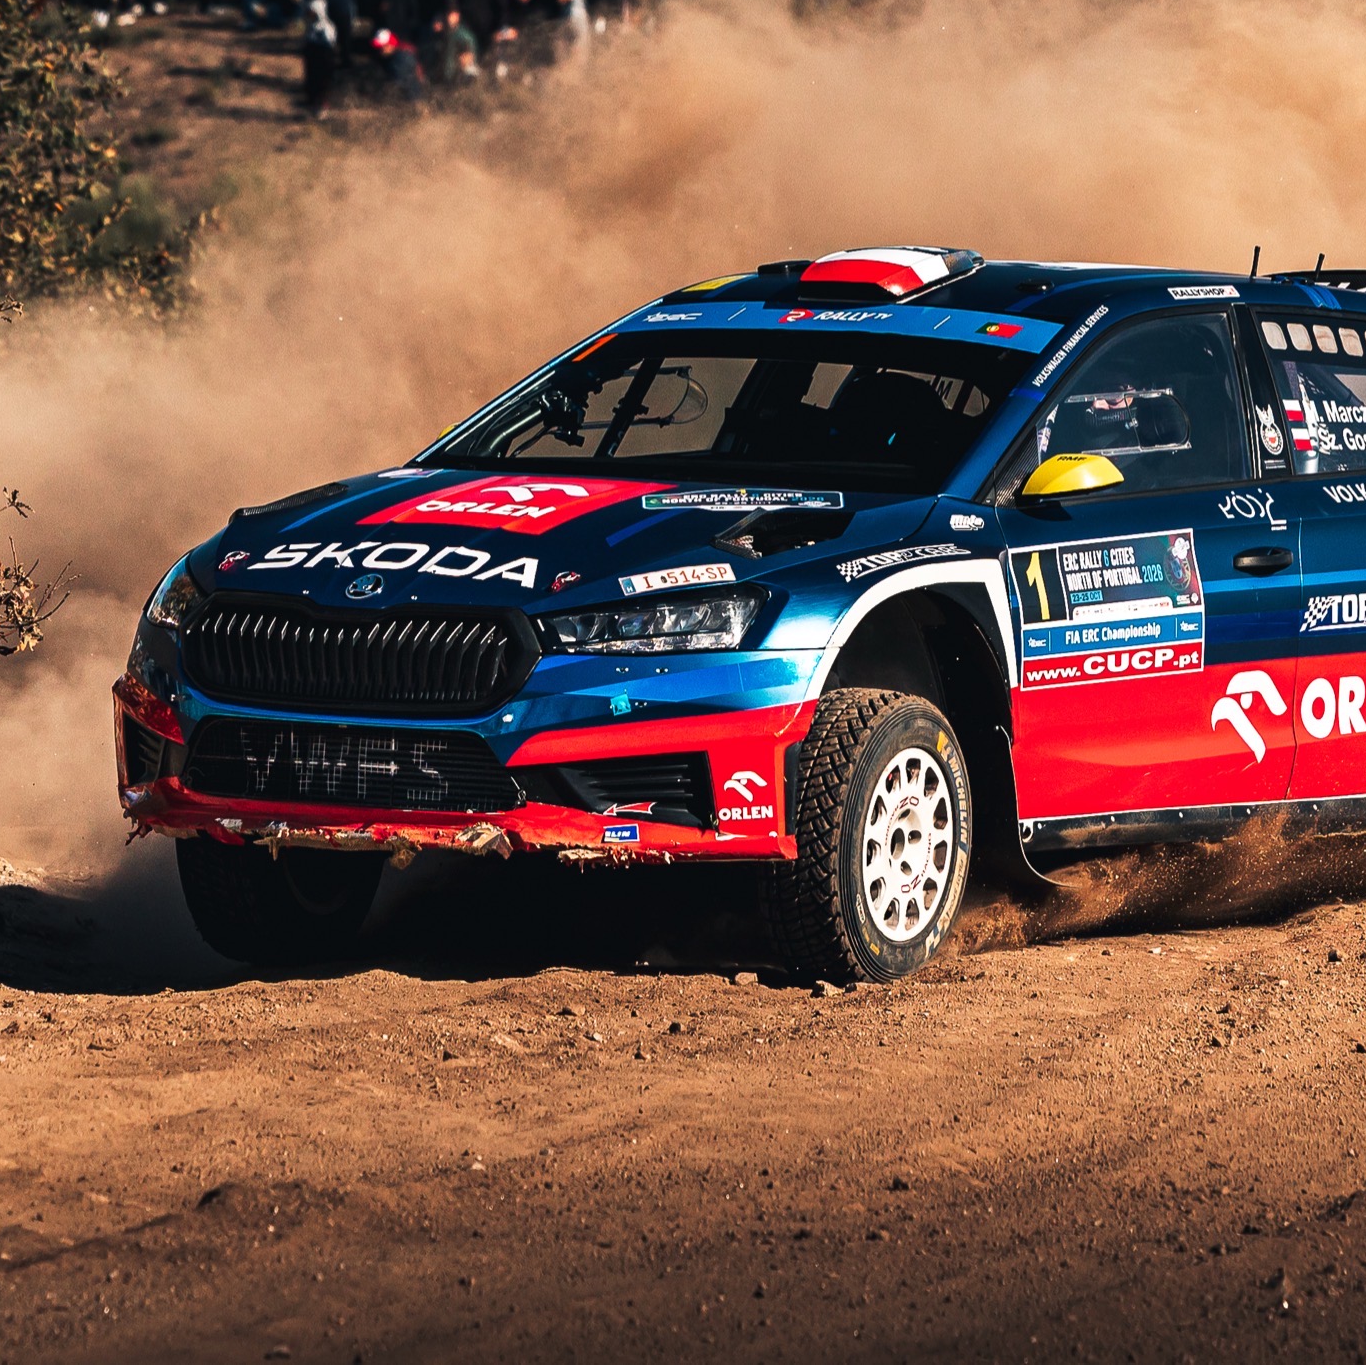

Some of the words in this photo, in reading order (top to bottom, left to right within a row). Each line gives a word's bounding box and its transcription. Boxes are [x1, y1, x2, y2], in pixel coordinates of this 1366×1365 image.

[812, 311, 876, 322] RALLY
[1031, 348, 1068, 388] VOLKSWAGEN
[1061, 324, 1090, 354] FINANCIAL
[1084, 304, 1110, 329] SERVICES
[414, 497, 558, 521] ORLEN
[1062, 552, 1080, 572] ERC
[1079, 549, 1103, 569] RALLY
[1102, 549, 1110, 567] 6
[1109, 546, 1136, 566] CITIES
[666, 566, 727, 585] 514-SP
[1025, 551, 1051, 621] 1
[1066, 571, 1094, 592] NORTH
[1093, 569, 1103, 589] OF
[1102, 566, 1143, 588] PORTUGAL
[1141, 563, 1164, 583] 2026
[1064, 630, 1081, 645] FIA
[1081, 628, 1100, 643] ERC
[1101, 621, 1161, 642] Championship
[1026, 648, 1199, 683] www.CUCP.pt
[718, 804, 774, 822] ORLEN
[947, 757, 970, 844] MICHELIN
